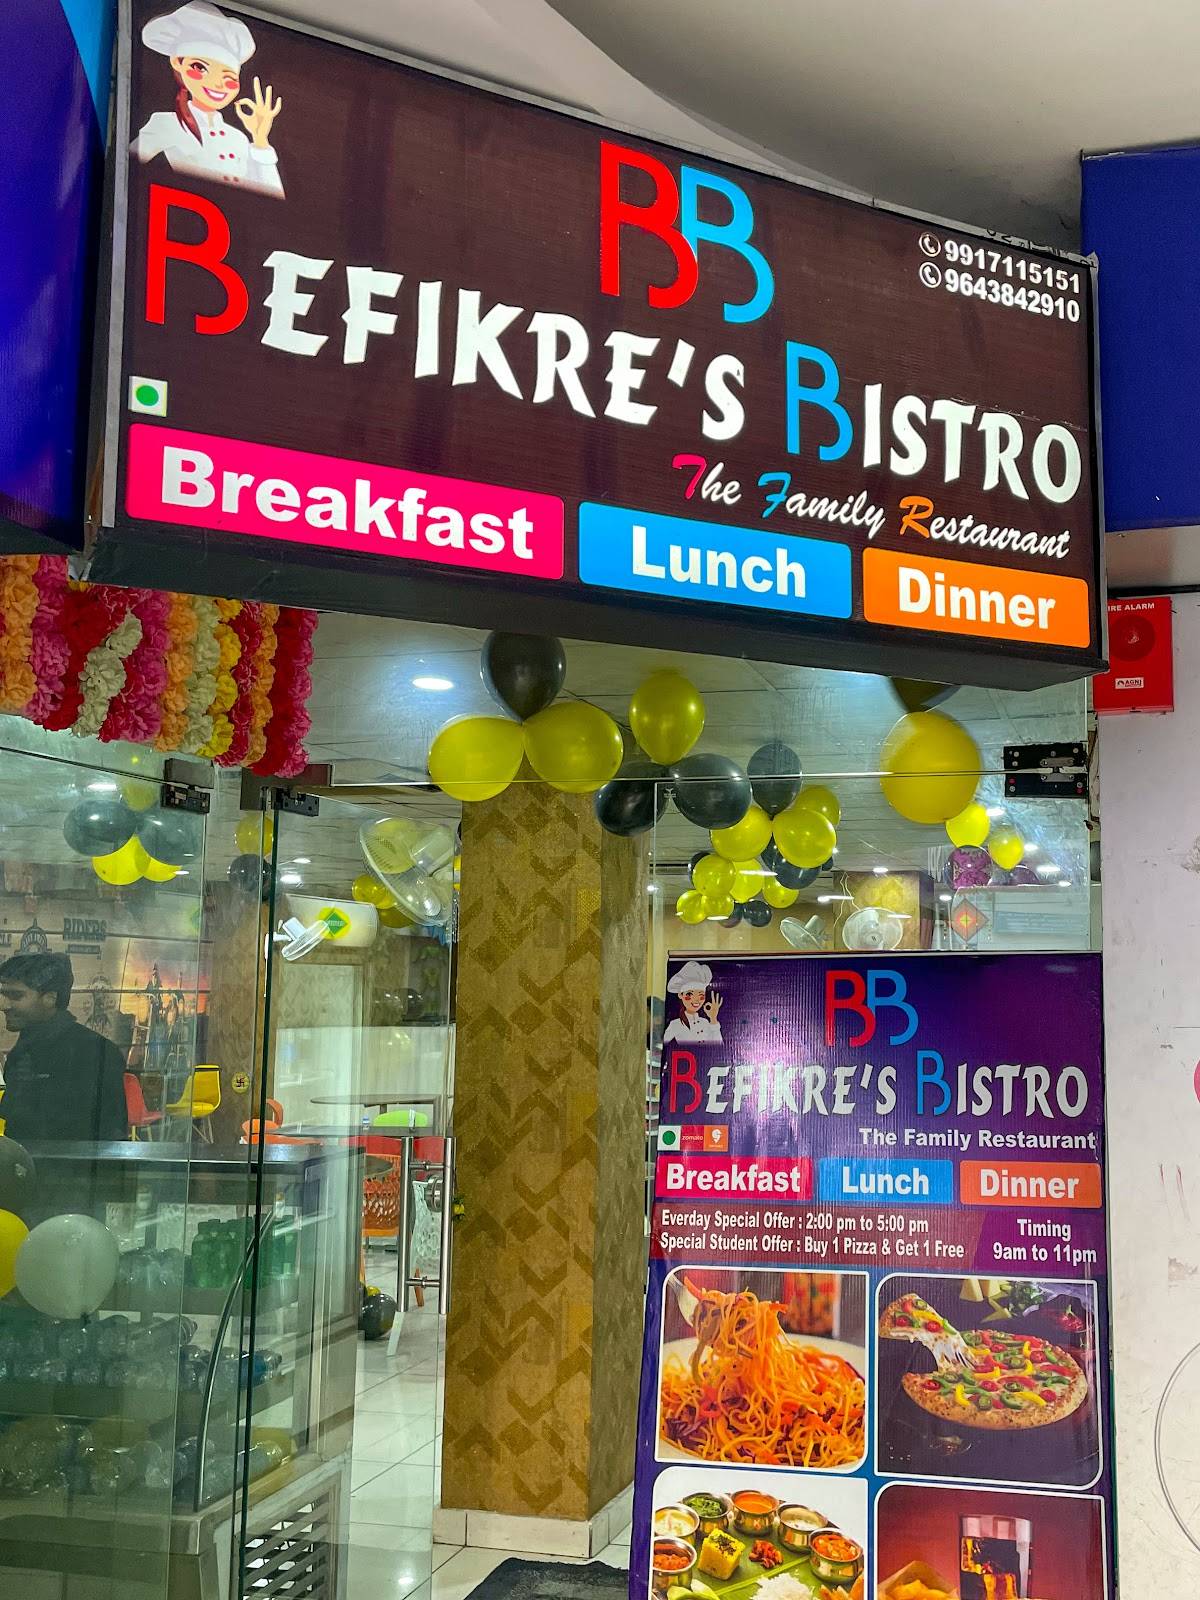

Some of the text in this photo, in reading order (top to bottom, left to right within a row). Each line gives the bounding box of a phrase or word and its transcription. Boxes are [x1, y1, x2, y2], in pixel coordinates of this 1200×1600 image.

[944, 239, 1080, 294] 9917115151
[944, 268, 1081, 323] 9643842910
[144, 183, 1082, 503] BEFIKRE'S BISTRO
[161, 445, 535, 560] Breakfast
[672, 454, 1071, 559] The Family Restaurant
[631, 525, 807, 599] Lunch
[898, 566, 1056, 630] Dinner
[1124, 602, 1155, 611] ALARM
[668, 1050, 1089, 1118] BEFIKRE'S BISTRO
[859, 1127, 1096, 1151] The Family Restaurant
[666, 1163, 801, 1193] Breakfast
[842, 1166, 929, 1196] Lunch
[980, 1168, 1080, 1200] Dinner
[661, 1209, 711, 1231] Everday
[714, 1210, 760, 1231] Special
[763, 1211, 796, 1230] Offer
[805, 1212, 834, 1231] 2:00
[836, 1217, 857, 1234] pm
[859, 1215, 874, 1232] to
[876, 1214, 905, 1233] 5:00
[908, 1218, 930, 1236] pm
[1016, 1218, 1072, 1242] Timing
[660, 1231, 706, 1254] Special
[709, 1233, 759, 1252] Student
[761, 1234, 794, 1252] Offer
[804, 1235, 829, 1258] Buy
[831, 1238, 841, 1255] 1
[843, 1237, 878, 1256] Pizza
[881, 1238, 892, 1256] &
[895, 1239, 919, 1257] Get
[922, 1239, 931, 1257] 1
[934, 1239, 966, 1258] Free
[993, 1242, 1098, 1267] 9am to 11pm
